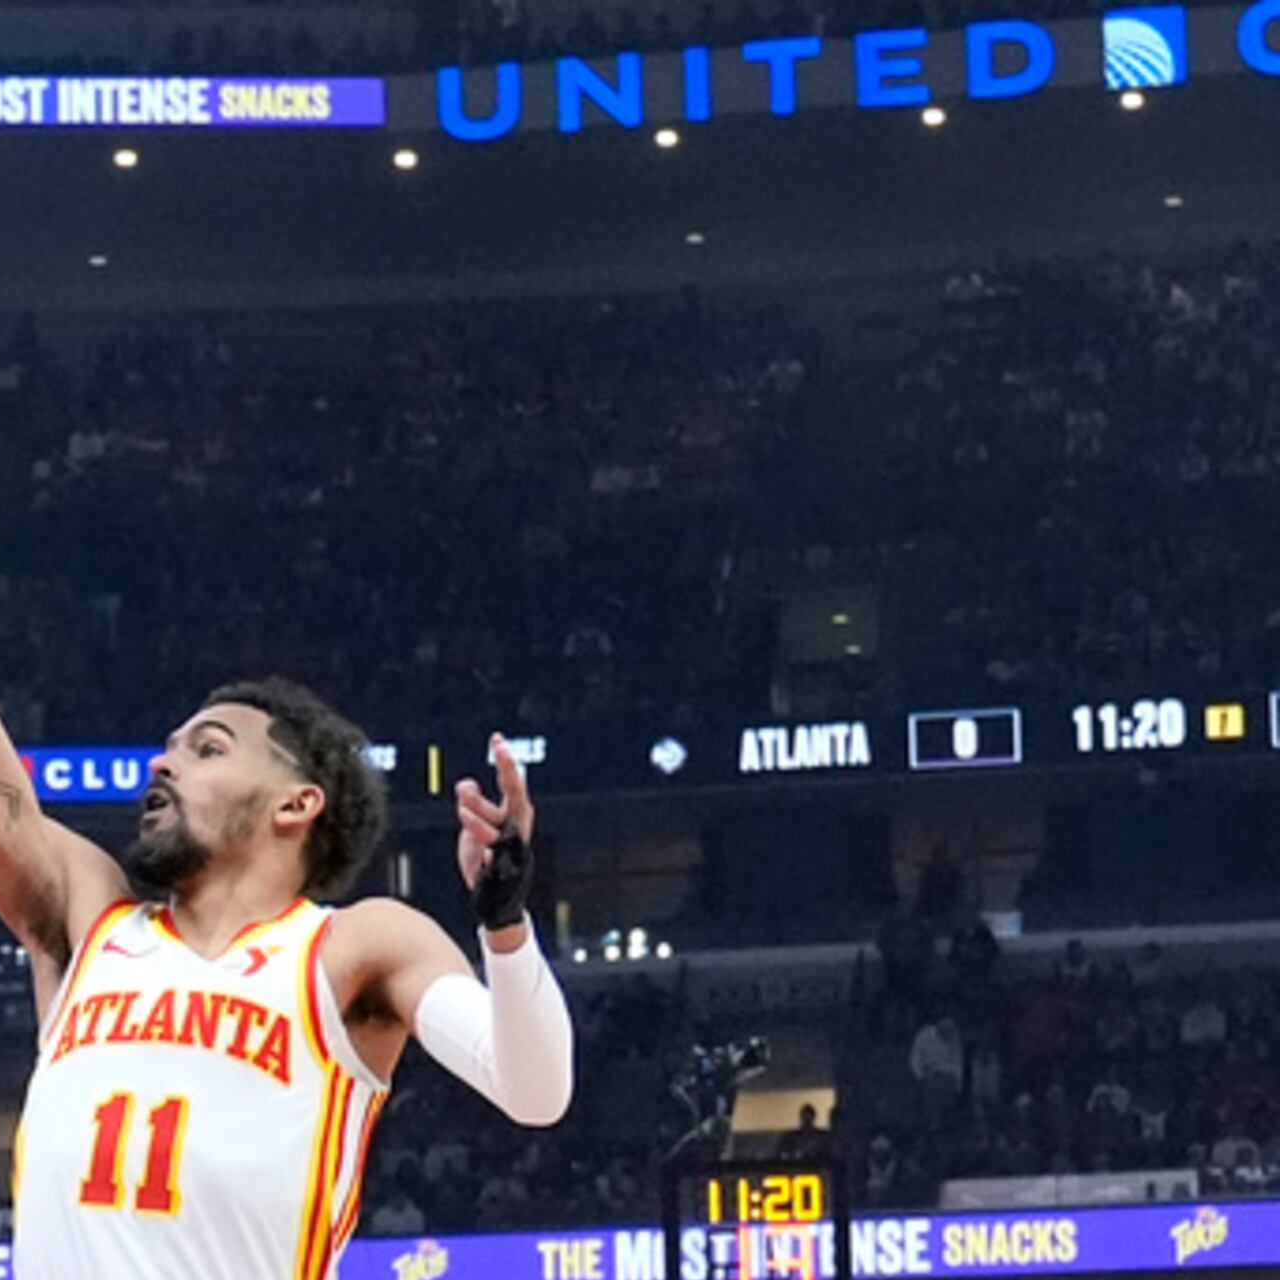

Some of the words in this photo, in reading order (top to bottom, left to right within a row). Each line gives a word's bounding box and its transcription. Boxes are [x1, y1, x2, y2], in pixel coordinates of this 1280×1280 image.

[57, 80, 211, 123] INTENSE
[219, 85, 330, 119] SNACKS
[439, 19, 1054, 141] UNITED
[740, 722, 870, 772] ATLANTA
[952, 717, 977, 759] 0
[1073, 699, 1186, 752] 11:20
[44, 758, 138, 790] CLU
[50, 989, 292, 1087] ATLANTA
[78, 1090, 190, 1217] 11
[708, 1174, 822, 1223] 11:20
[943, 1220, 1078, 1268] SNACKS
